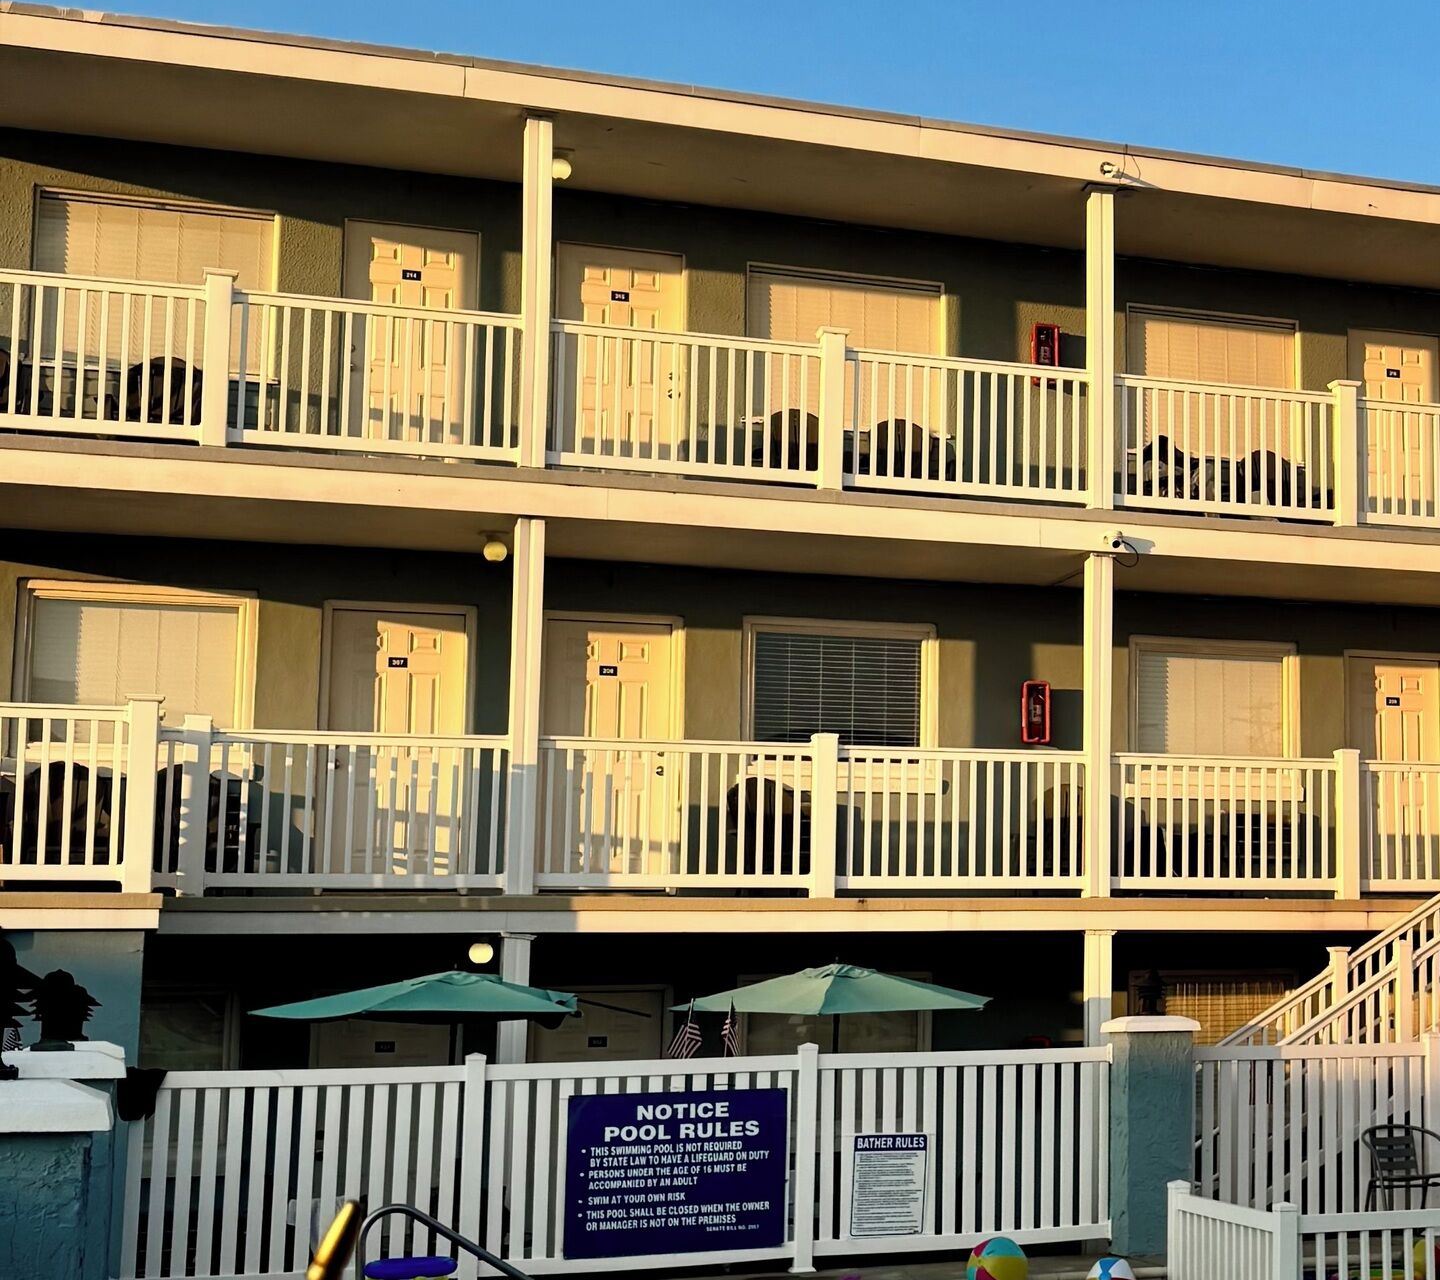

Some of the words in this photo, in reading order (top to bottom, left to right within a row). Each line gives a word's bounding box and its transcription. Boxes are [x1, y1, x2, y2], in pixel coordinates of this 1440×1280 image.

[637, 1102, 729, 1121] NOTICE
[604, 1124, 671, 1142] POOL
[679, 1120, 760, 1139] RULES
[590, 1146, 609, 1156] THIS
[611, 1145, 651, 1156] SWIMMING
[653, 1144, 674, 1154] POOL
[676, 1143, 684, 1153] IS
[685, 1142, 702, 1152] NOT
[703, 1141, 743, 1151] REQUIRED
[857, 1137, 893, 1149] BATHER
[895, 1136, 925, 1148] RULES
[590, 1158, 601, 1168] BY
[603, 1157, 628, 1167] STATE
[630, 1156, 647, 1166] LAW
[648, 1155, 659, 1165] TO
[661, 1154, 682, 1164] HAVE
[683, 1154, 689, 1163] A
[691, 1152, 734, 1163] LIFEGUARD
[735, 1151, 747, 1161] ON
[748, 1150, 770, 1160] DUTY
[588, 1169, 625, 1179] PERSONS
[627, 1168, 654, 1177] UNDER
[655, 1166, 671, 1176] THE
[672, 1166, 689, 1175] AGE
[690, 1165, 701, 1174] OF
[713, 1164, 735, 1173] MUST
[736, 1163, 747, 1172] BE
[588, 1179, 646, 1190] ACCOMPANIED
[647, 1178, 658, 1187] BY
[659, 1178, 671, 1186] AN
[672, 1176, 698, 1186] ADULT
[588, 1196, 610, 1206] SWIM
[611, 1195, 622, 1204] AT
[623, 1194, 646, 1204] YOUR
[647, 1193, 666, 1203] OWN
[667, 1192, 686, 1201] RISK
[586, 1210, 605, 1220] THIS
[606, 1209, 628, 1219] POOL
[629, 1207, 654, 1217] SHALL
[656, 1206, 667, 1215] BE
[668, 1205, 699, 1215] CLOSED
[700, 1204, 724, 1213] WHEN
[725, 1203, 740, 1212] THE
[742, 1201, 770, 1211] OWNER
[586, 1221, 598, 1231] OR
[599, 1220, 638, 1230] MANAGER
[639, 1219, 648, 1228] IS
[649, 1218, 666, 1227] NOT
[667, 1217, 680, 1227] ON
[681, 1216, 697, 1226] THE
[698, 1214, 737, 1225] PREMISES
